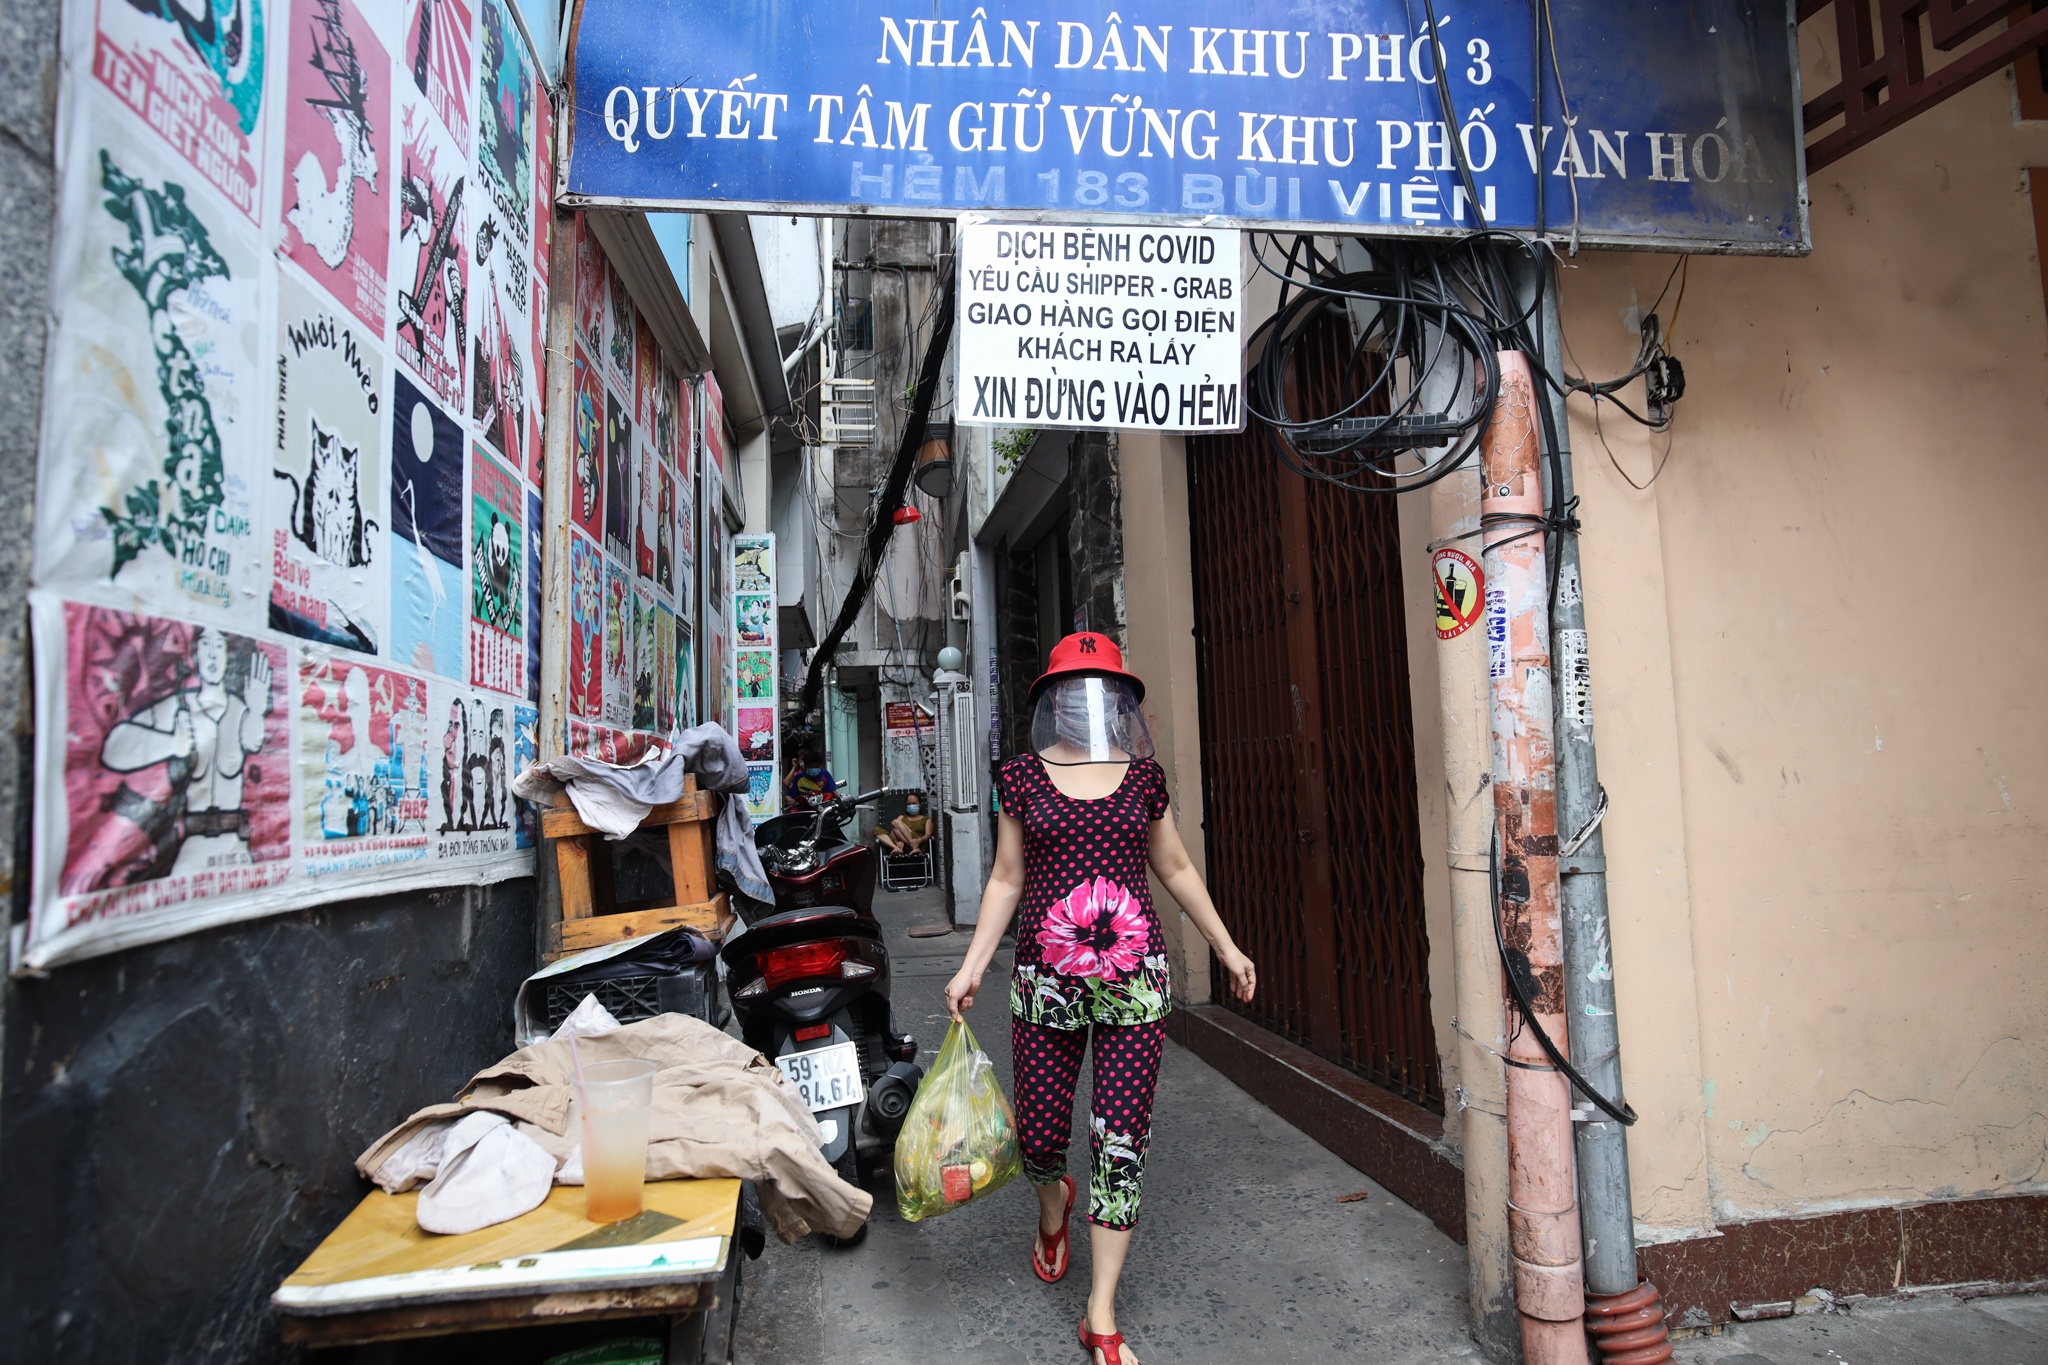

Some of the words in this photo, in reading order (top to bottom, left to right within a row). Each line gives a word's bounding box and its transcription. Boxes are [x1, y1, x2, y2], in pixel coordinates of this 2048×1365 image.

[877, 7, 1040, 69] NHÂN
[1055, 12, 1172, 73] DÂN
[1189, 27, 1310, 79] KHU
[1328, 15, 1451, 84] PHỐ
[1466, 38, 1493, 85] 3
[605, 73, 788, 153] QUYẾT
[809, 85, 931, 152] TÂM
[949, 89, 1052, 153] GIỮ
[1060, 93, 1221, 160] VỮNG
[1237, 112, 1357, 167] KHU
[1377, 102, 1497, 172] PHỐ
[1516, 115, 1629, 180] VĂN
[850, 153, 1001, 202] HẺM
[1038, 168, 1149, 207] 183
[1182, 167, 1300, 214] BÙI
[1328, 176, 1497, 225] VIỆN
[997, 231, 1055, 265] DỊCH
[1064, 228, 1131, 268] BỆNH
[1139, 234, 1215, 264] COVID
[969, 265, 1009, 291] YÊU
[1016, 266, 1059, 293] CẦU
[1066, 272, 1154, 297] SHIPPER
[1173, 276, 1232, 299] GRAB
[968, 302, 1032, 326] GIAO
[1041, 300, 1113, 329] HÀNG
[1123, 309, 1167, 337] GỌI
[1175, 307, 1234, 338] ĐIỆN
[1018, 332, 1101, 361] KHÁCH
[1110, 340, 1142, 364] RA
[1150, 338, 1196, 365] LẤY
[972, 375, 1016, 418] XIN
[1025, 367, 1105, 422] ĐỪNG
[1114, 371, 1170, 425] VÀO
[1179, 374, 1237, 426] HẺM
[790, 987, 823, 998] HONDA
